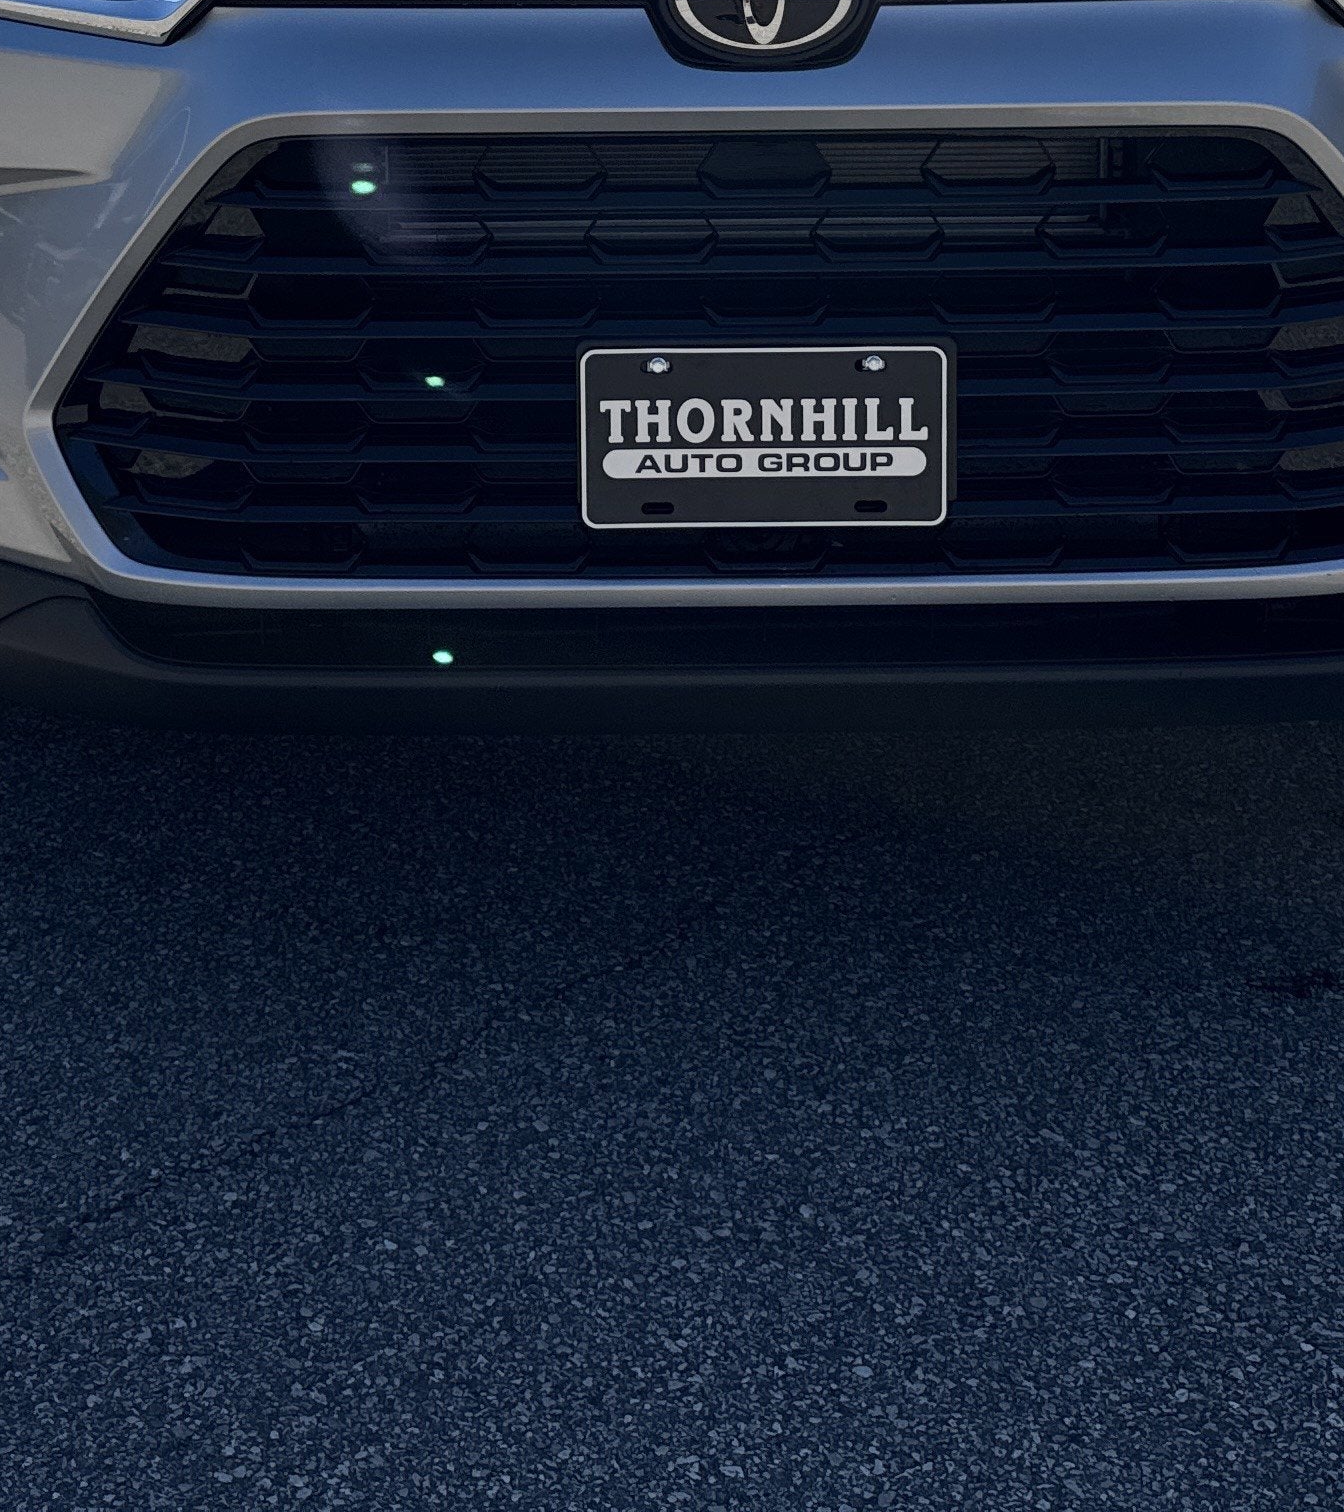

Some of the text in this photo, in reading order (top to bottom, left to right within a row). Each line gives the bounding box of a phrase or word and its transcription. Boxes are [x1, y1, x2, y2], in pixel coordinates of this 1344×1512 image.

[599, 397, 929, 444] THORNHILL
[634, 452, 894, 474] AUTO GROUP
